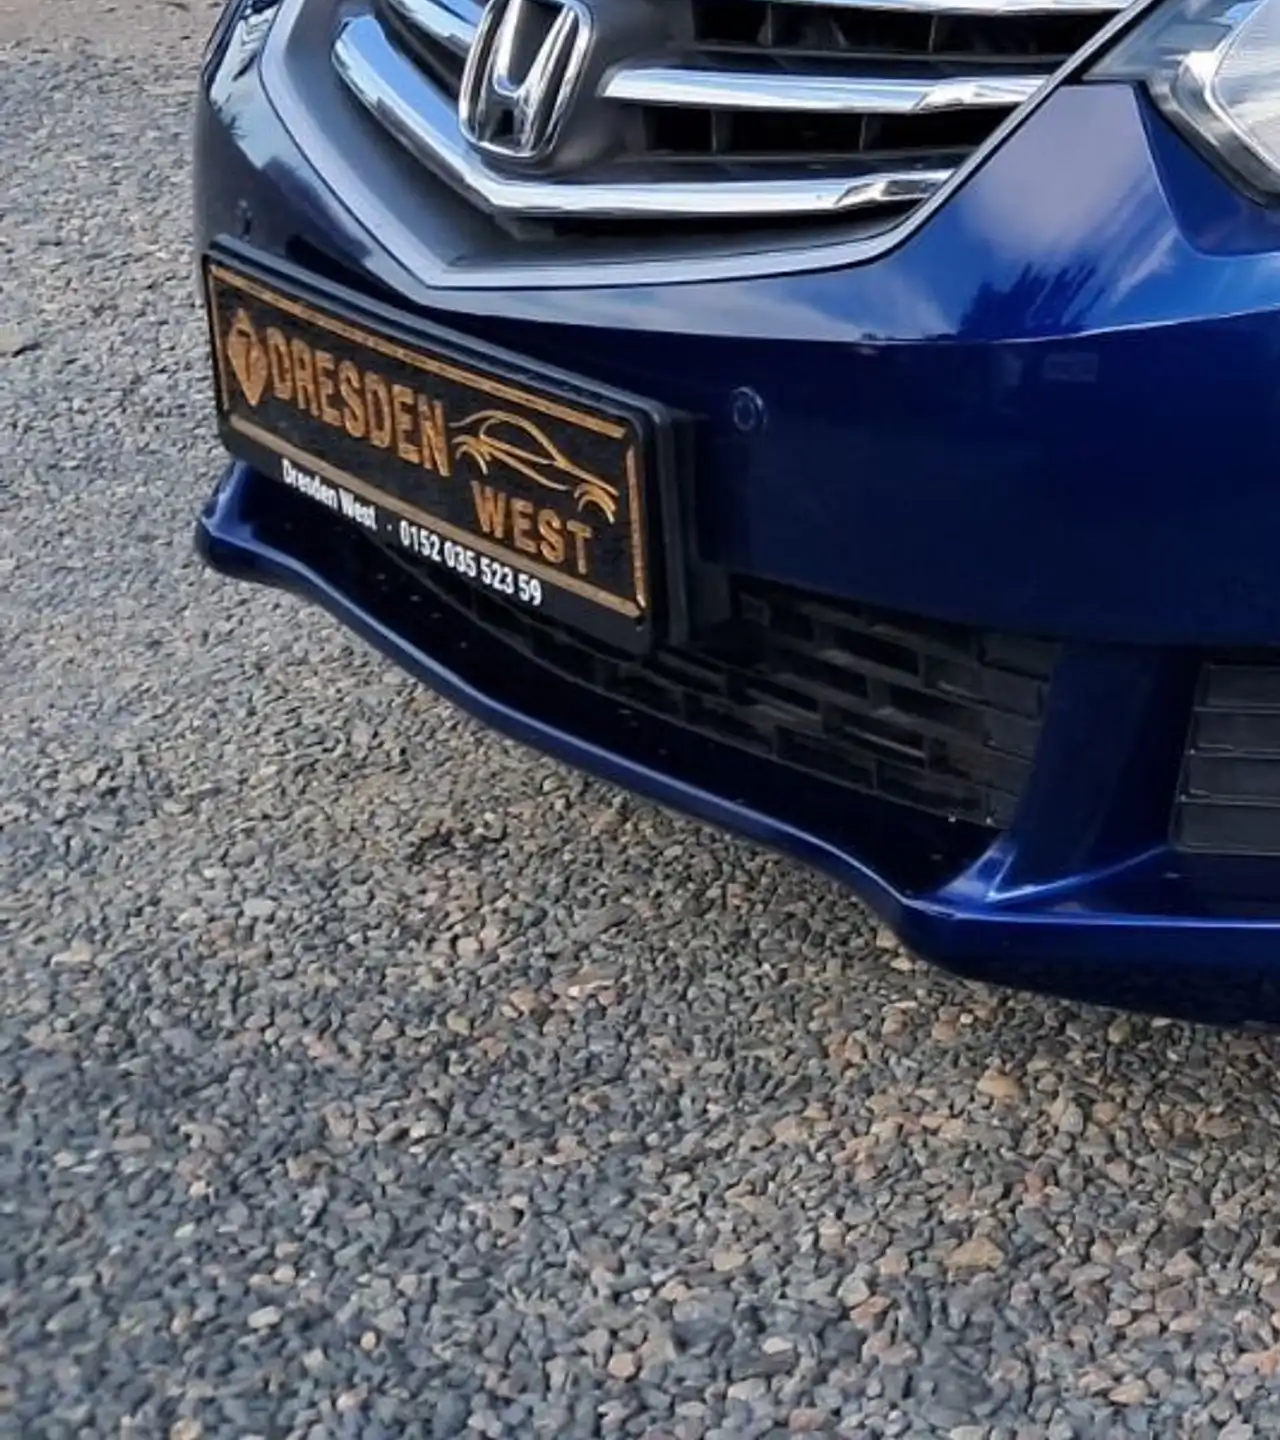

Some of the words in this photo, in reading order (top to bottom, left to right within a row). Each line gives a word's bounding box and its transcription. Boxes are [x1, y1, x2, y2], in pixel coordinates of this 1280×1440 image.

[266, 326, 451, 477] DRESDEN
[282, 457, 339, 511] Dresden
[339, 487, 378, 532] West
[400, 520, 442, 562] 0152
[443, 540, 477, 577] 035
[479, 556, 515, 594] 523
[517, 574, 543, 606] 59
[469, 480, 593, 575] WEST
